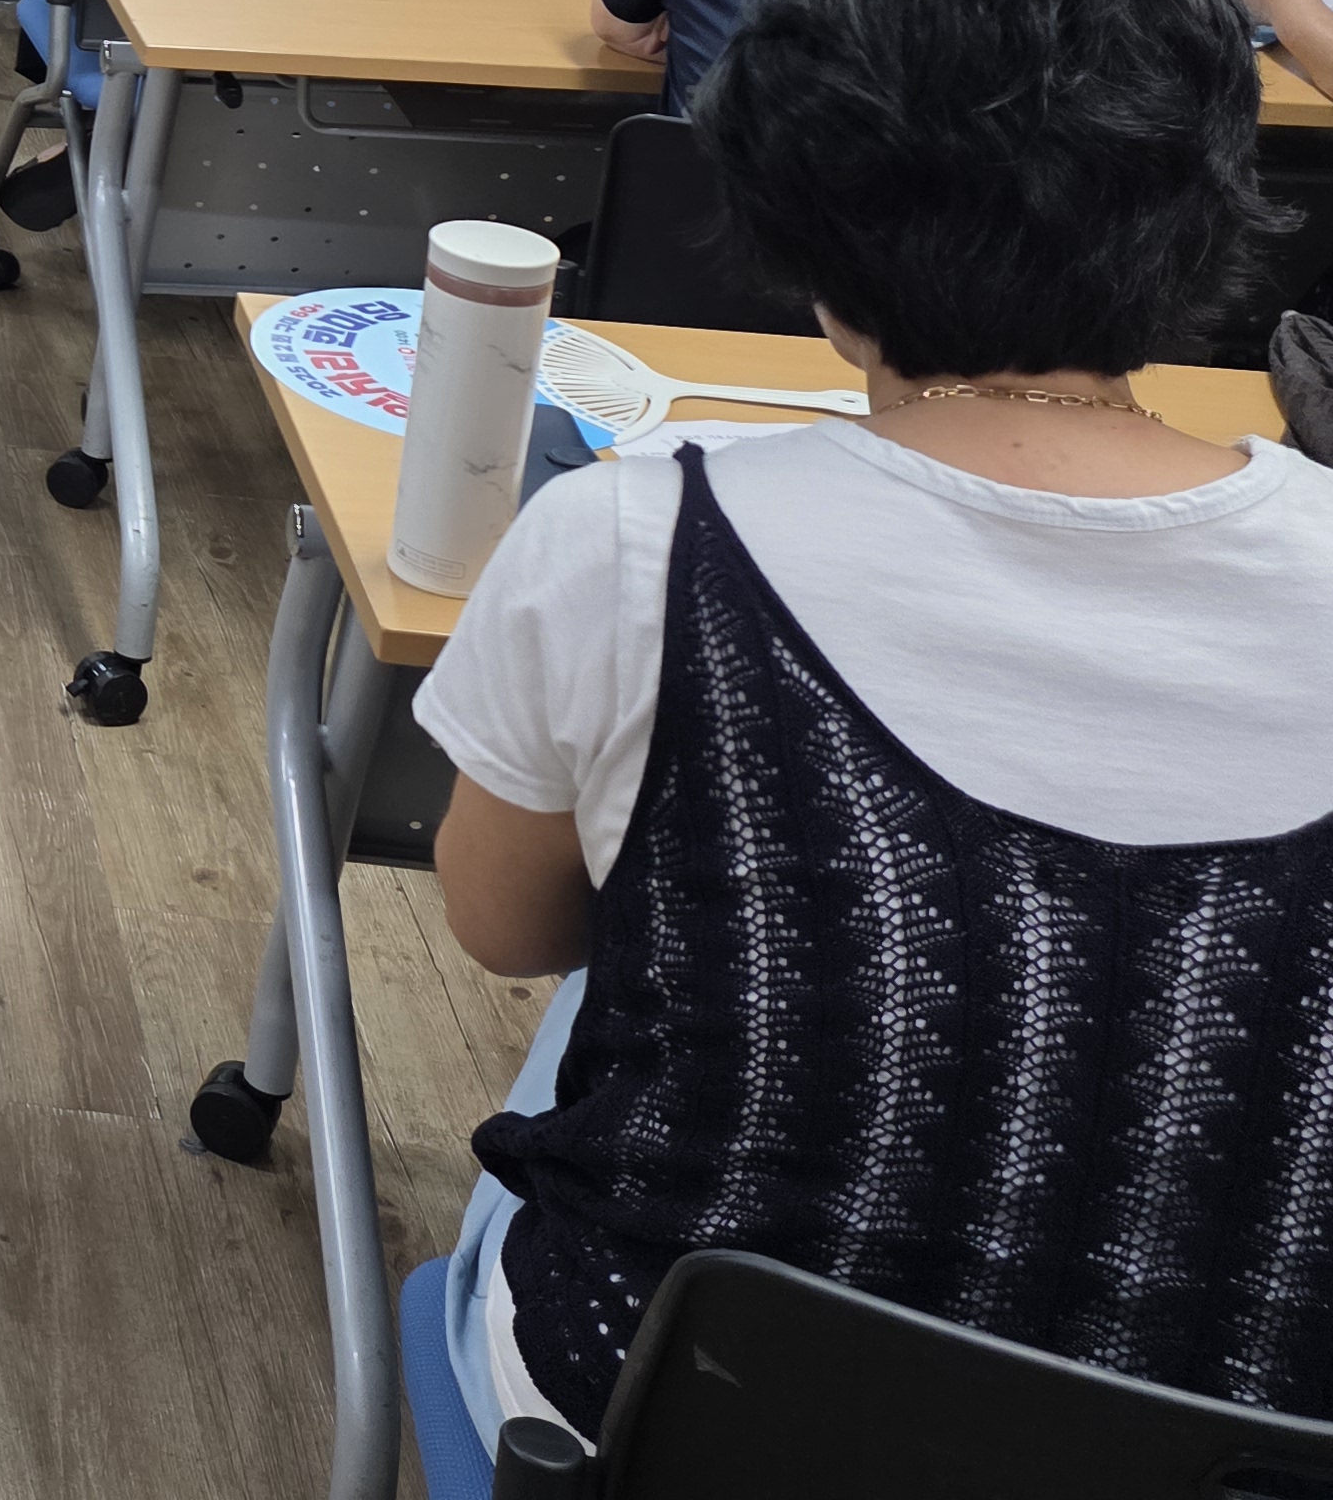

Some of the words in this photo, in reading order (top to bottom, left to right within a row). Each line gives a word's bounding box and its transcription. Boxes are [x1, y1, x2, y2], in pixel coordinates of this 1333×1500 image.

[274, 315, 302, 333] 구미
[303, 300, 411, 348] 한마당
[286, 365, 343, 398] 2025
